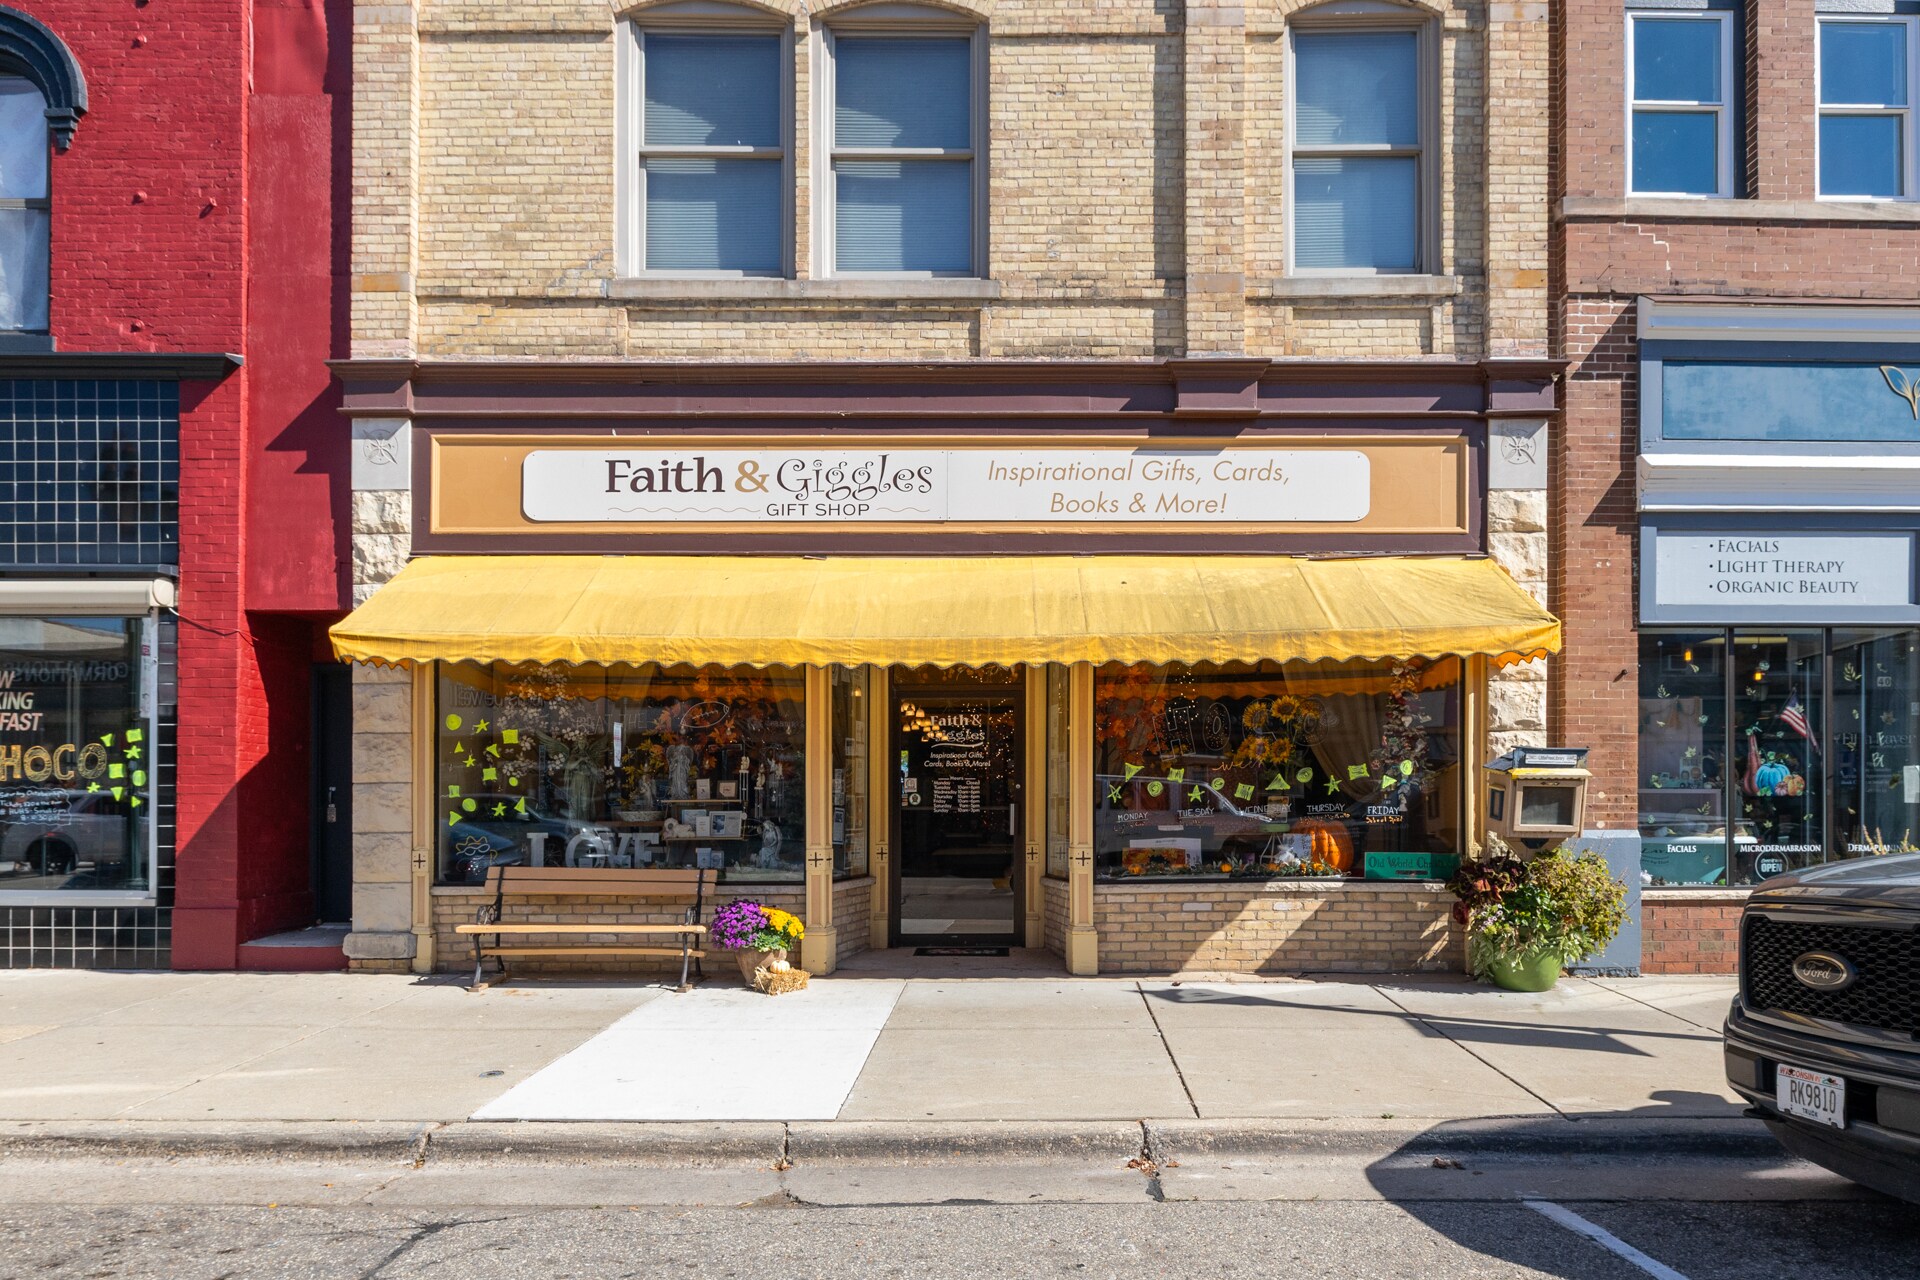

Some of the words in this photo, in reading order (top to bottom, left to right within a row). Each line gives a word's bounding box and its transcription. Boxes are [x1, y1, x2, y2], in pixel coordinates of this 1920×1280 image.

[605, 457, 725, 493] Faith
[734, 460, 769, 493] &
[776, 454, 933, 501] Giggles
[988, 459, 1133, 487] Inspirational
[1142, 460, 1201, 485] Gifts,
[1213, 459, 1290, 485] Cards,
[766, 503, 809, 516] GIFT
[816, 503, 870, 516] SHOP
[1050, 492, 1119, 514] Books
[1129, 492, 1147, 514] &
[1155, 492, 1227, 514] More!
[1718, 540, 1780, 553] FACIALS
[1718, 560, 1768, 573] LIGHT
[1772, 560, 1845, 573] THERAPY
[1717, 580, 1794, 594] ORGANIC
[1800, 580, 1859, 594] BEAUTY
[930, 714, 969, 726] Faith
[971, 714, 982, 726] &
[930, 751, 968, 760] Inspirational
[1177, 807, 1215, 817] TUESDAY
[1306, 803, 1346, 813] THURSDAY
[1367, 805, 1399, 815] FRIDAY
[1117, 811, 1148, 821] MONDAY
[1667, 844, 1697, 853] FACIALS
[1740, 844, 1822, 853] MICRODERMABRASION
[1761, 863, 1783, 873] OPEN
[1803, 961, 1832, 980] Ford
[1780, 1066, 1814, 1082] WISCONSIN
[1790, 1079, 1837, 1114] RK9810
